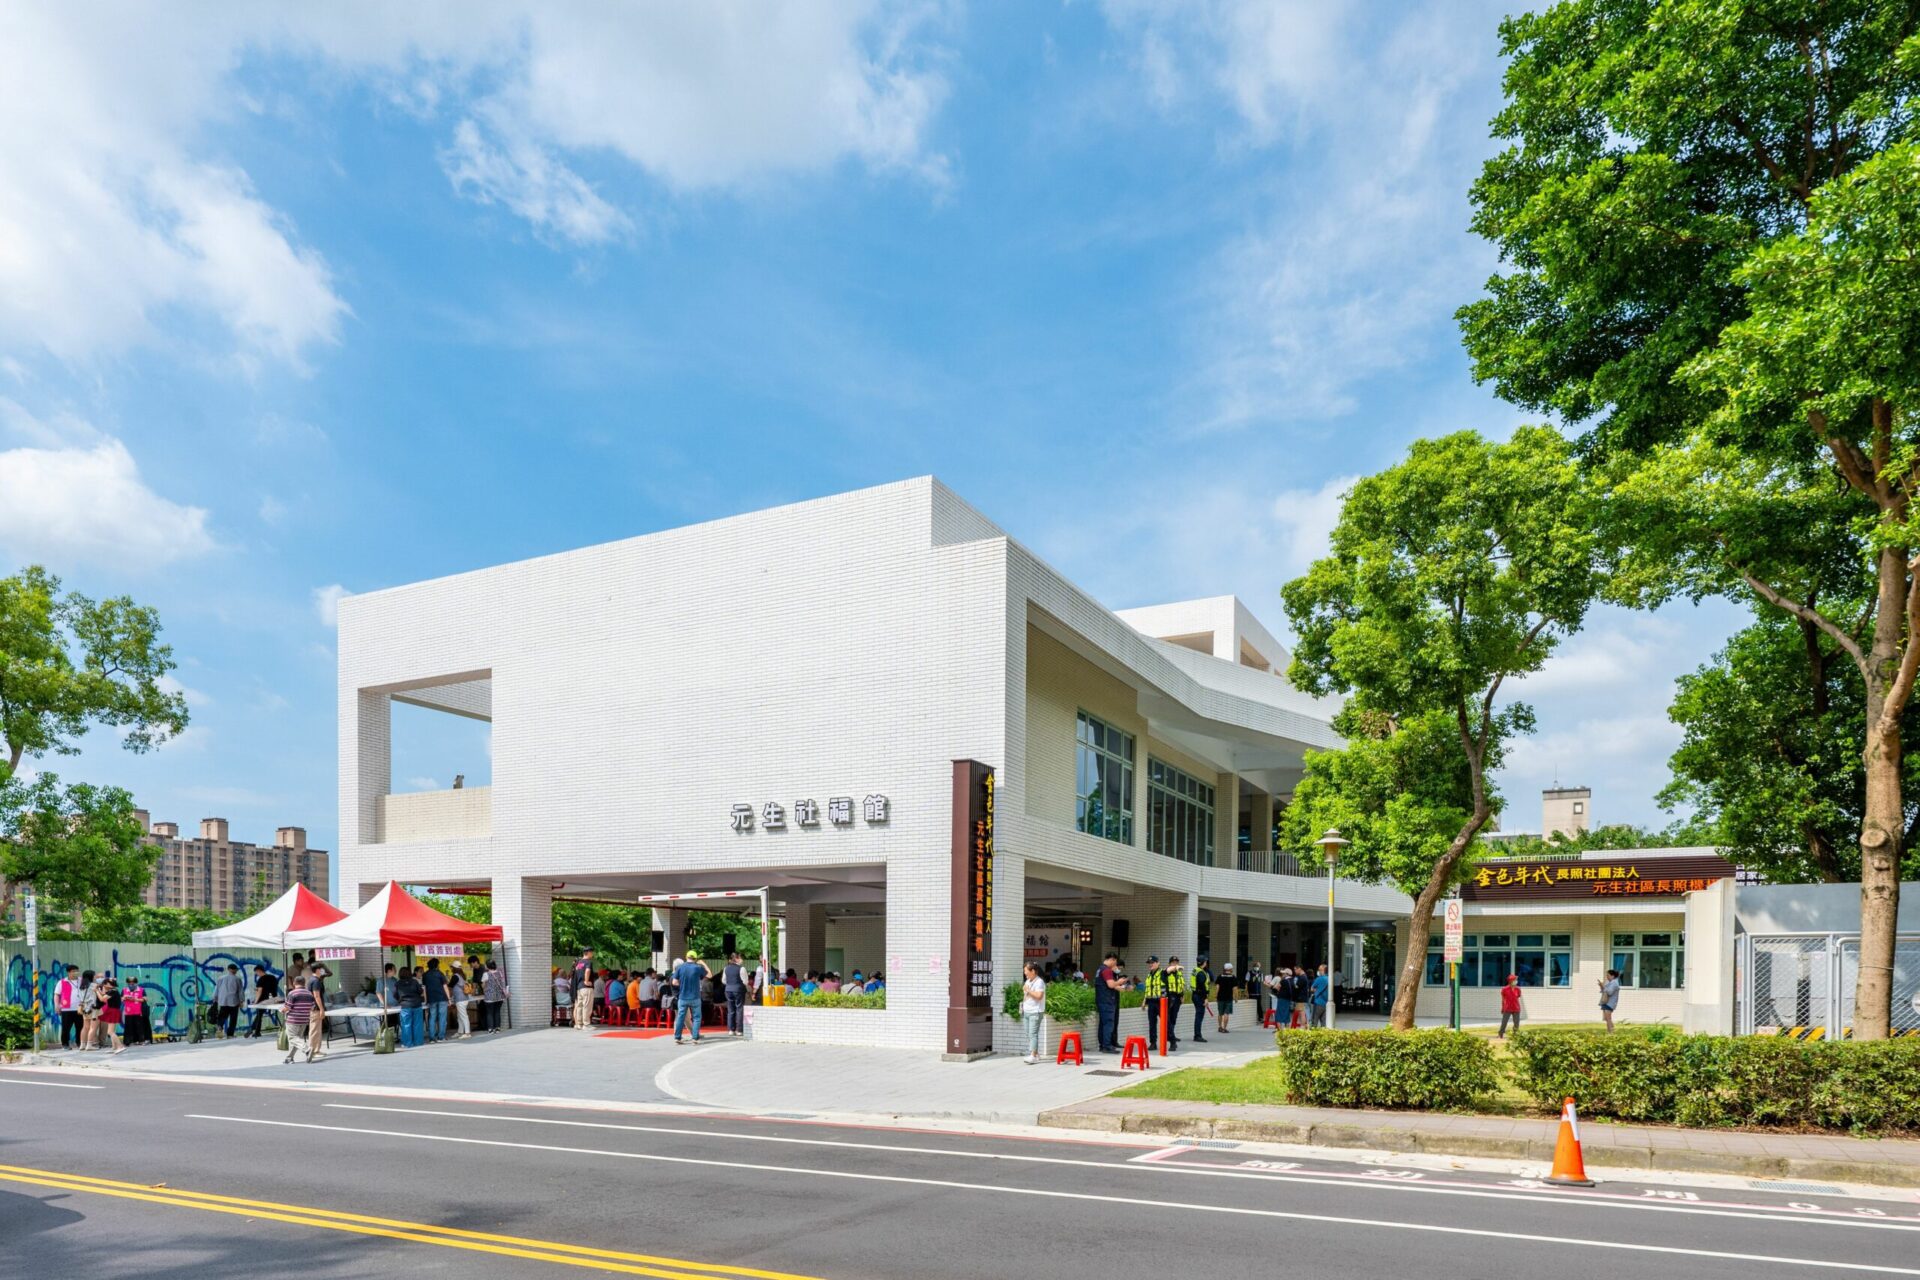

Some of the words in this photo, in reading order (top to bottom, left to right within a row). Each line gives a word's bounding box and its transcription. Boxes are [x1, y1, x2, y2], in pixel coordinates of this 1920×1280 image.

[731, 795, 888, 829] 元生社福館
